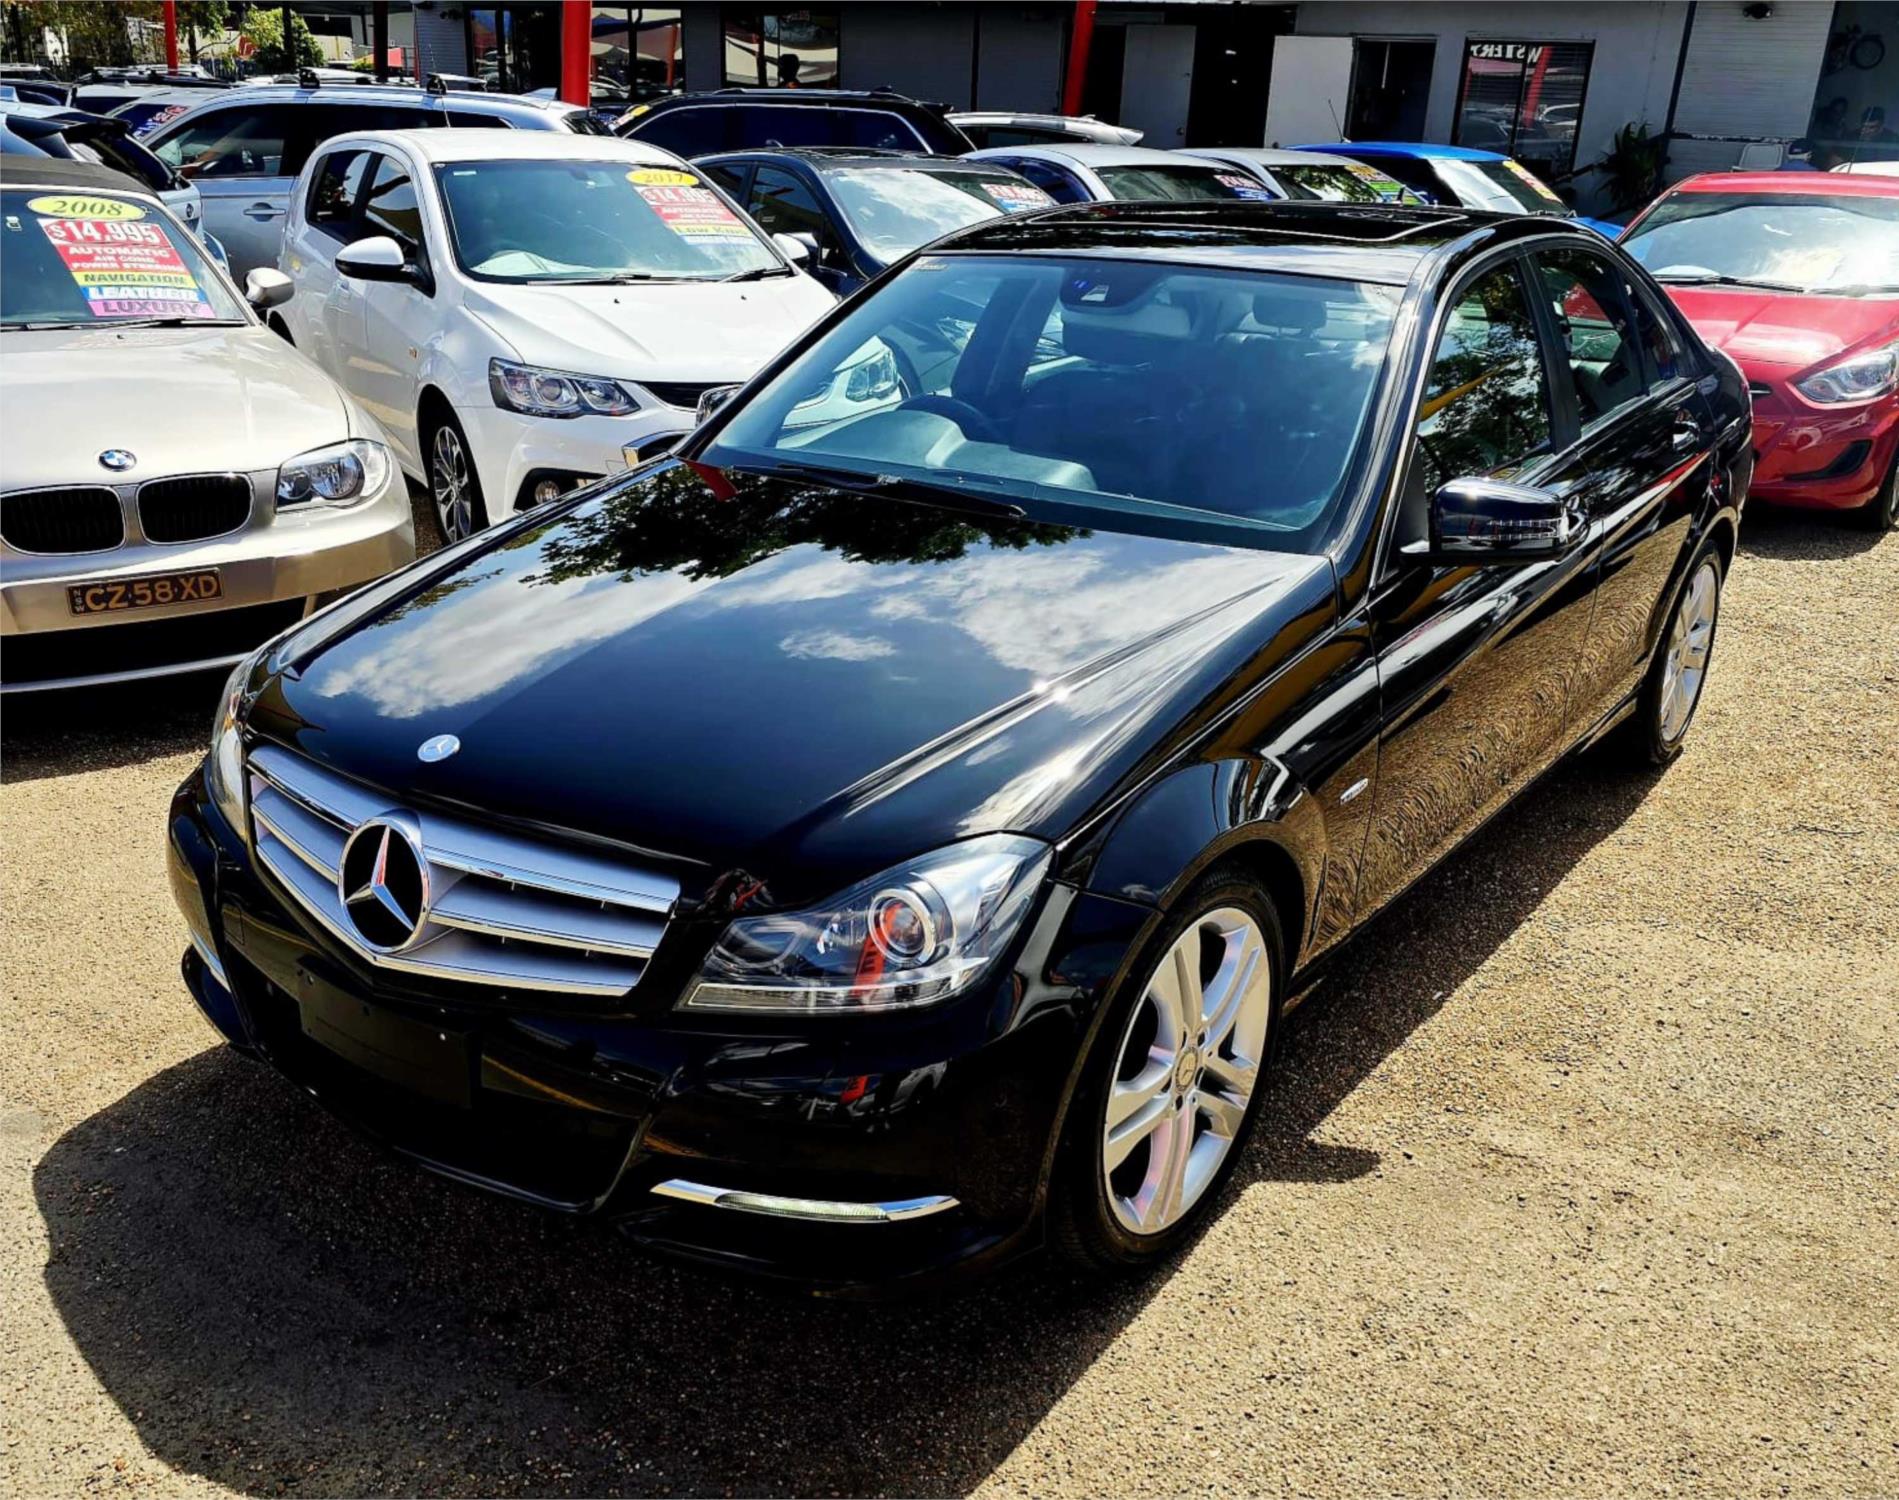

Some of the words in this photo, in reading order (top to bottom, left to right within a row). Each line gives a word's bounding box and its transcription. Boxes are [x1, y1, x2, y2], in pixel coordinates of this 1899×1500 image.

[643, 173, 684, 183] 2017
[52, 200, 124, 217] 2008
[51, 220, 162, 244] $14,995
[68, 246, 171, 258] AUTOMATIC
[94, 255, 117, 263] AIR
[71, 262, 120, 271] POWER
[83, 273, 187, 286] NAVIGATION
[88, 286, 199, 301] LEATHER
[102, 300, 200, 314] LUXURY
